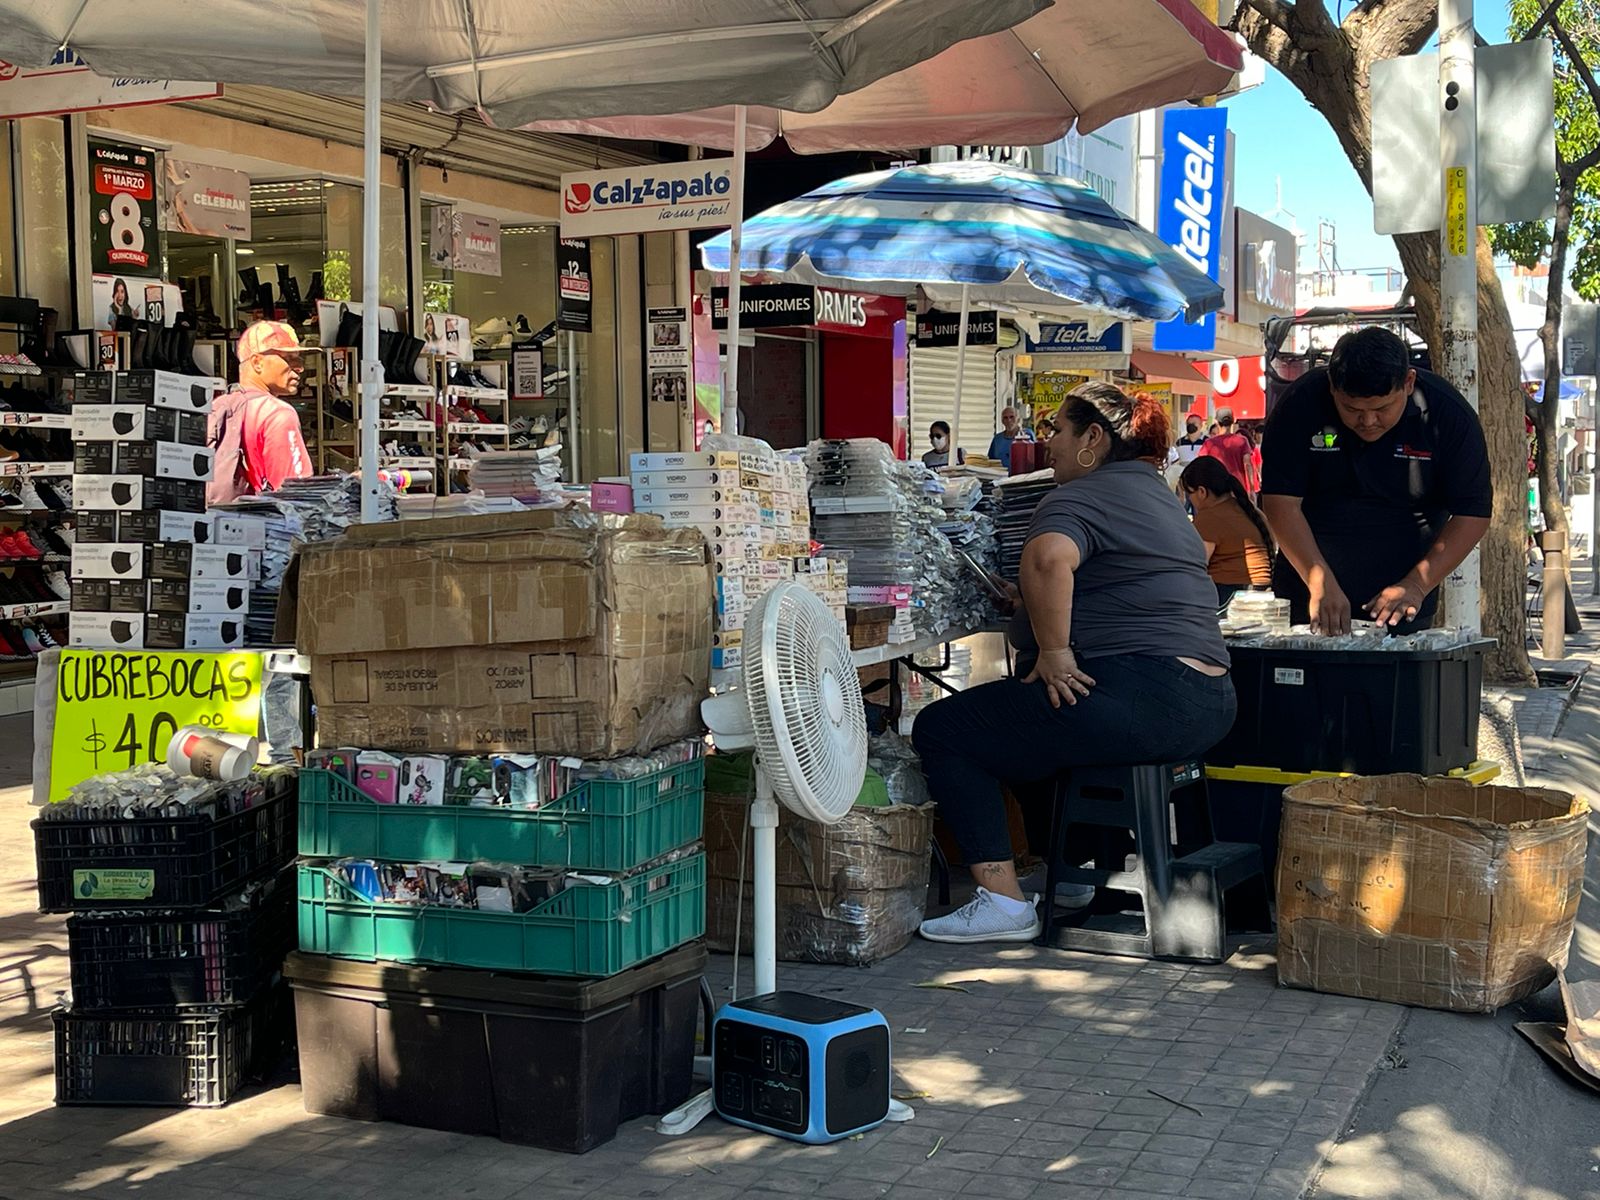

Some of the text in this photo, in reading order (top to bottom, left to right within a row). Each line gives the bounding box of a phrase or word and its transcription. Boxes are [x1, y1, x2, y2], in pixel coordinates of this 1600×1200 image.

[116, 174, 145, 190] MARZO
[193, 193, 246, 212] CELEBRAN
[696, 202, 731, 222] pies!
[110, 192, 145, 252] 8
[465, 237, 497, 254] BAILAN
[112, 251, 146, 264] QUINCENAS
[568, 260, 580, 279] 12
[148, 302, 162, 322] 30
[934, 322, 994, 336] UNIFRMES
[102, 345, 113, 359] 30
[334, 359, 344, 372] 30
[1052, 384, 1065, 393] en
[668, 492, 688, 500] VIDRIO
[670, 510, 690, 518] VIDRIO
[60, 652, 252, 702] CUBREBOCAS
[412, 670, 438, 679] TRIGO
[384, 682, 396, 692] DE
[495, 680, 525, 689] ARROZ
